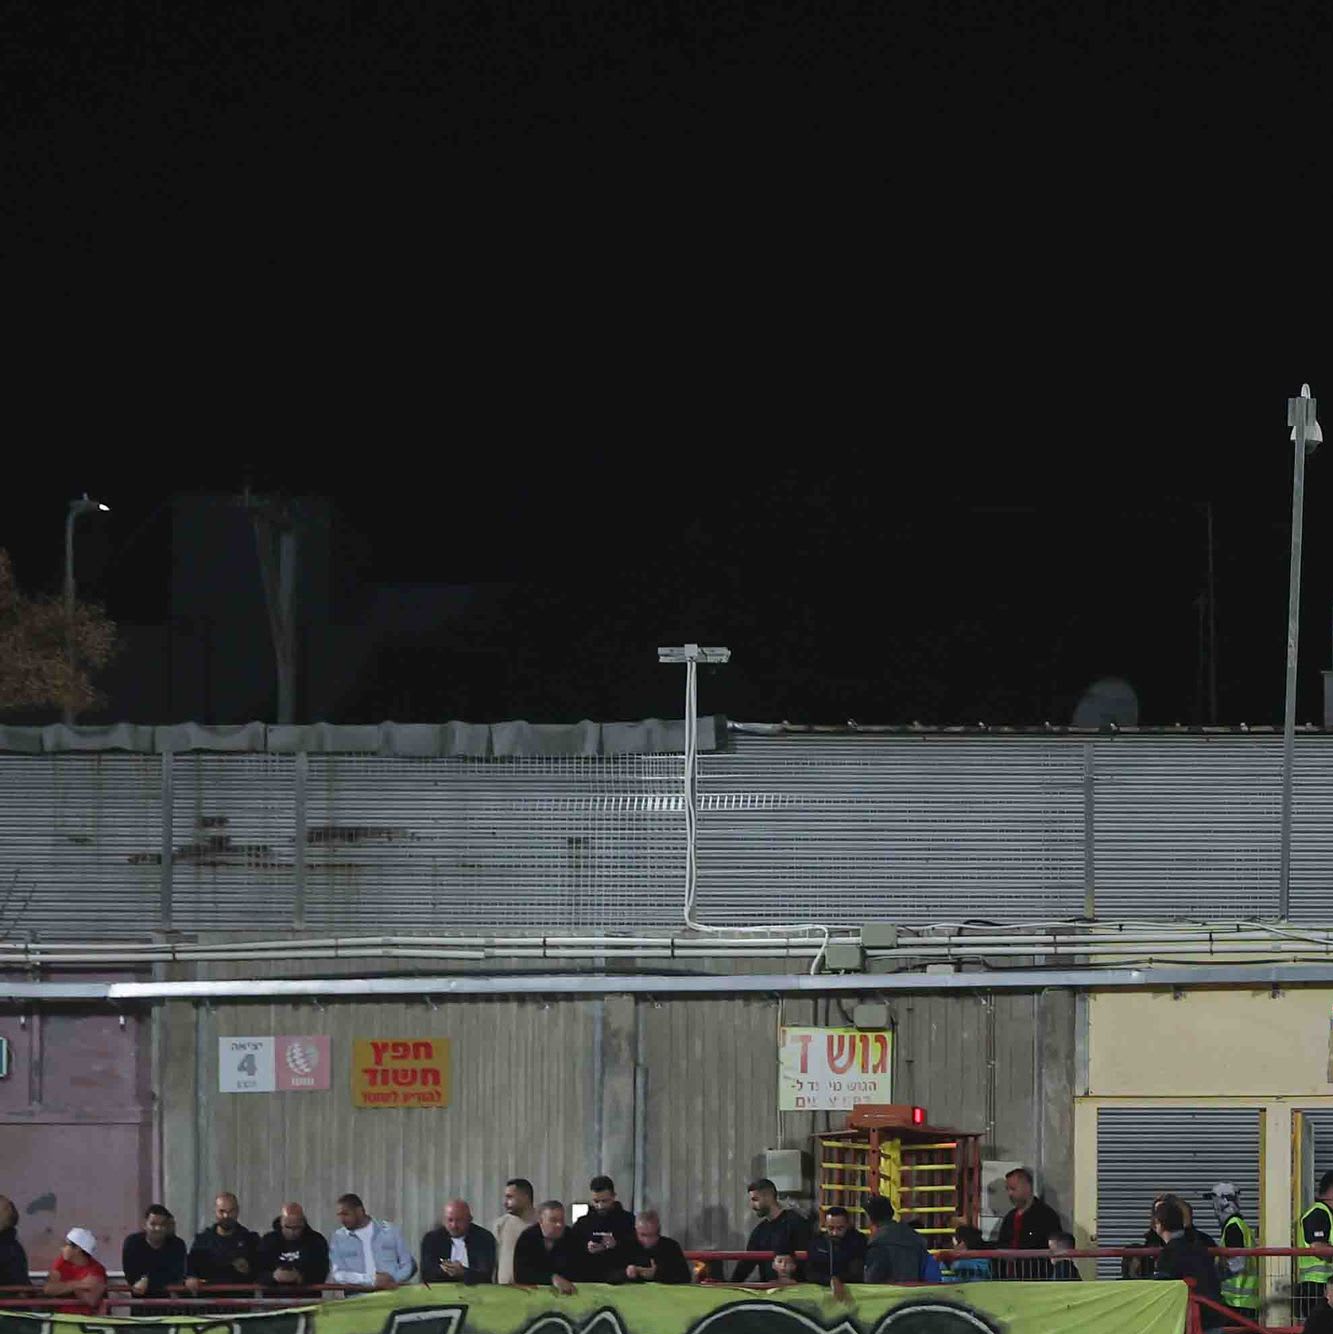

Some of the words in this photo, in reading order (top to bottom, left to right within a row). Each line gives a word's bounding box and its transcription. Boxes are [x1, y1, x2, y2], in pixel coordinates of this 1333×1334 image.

[237, 1053, 257, 1077] 4
[369, 1040, 433, 1067] חפץ
[827, 1033, 888, 1074] גוש
[361, 1067, 441, 1087] חשוד
